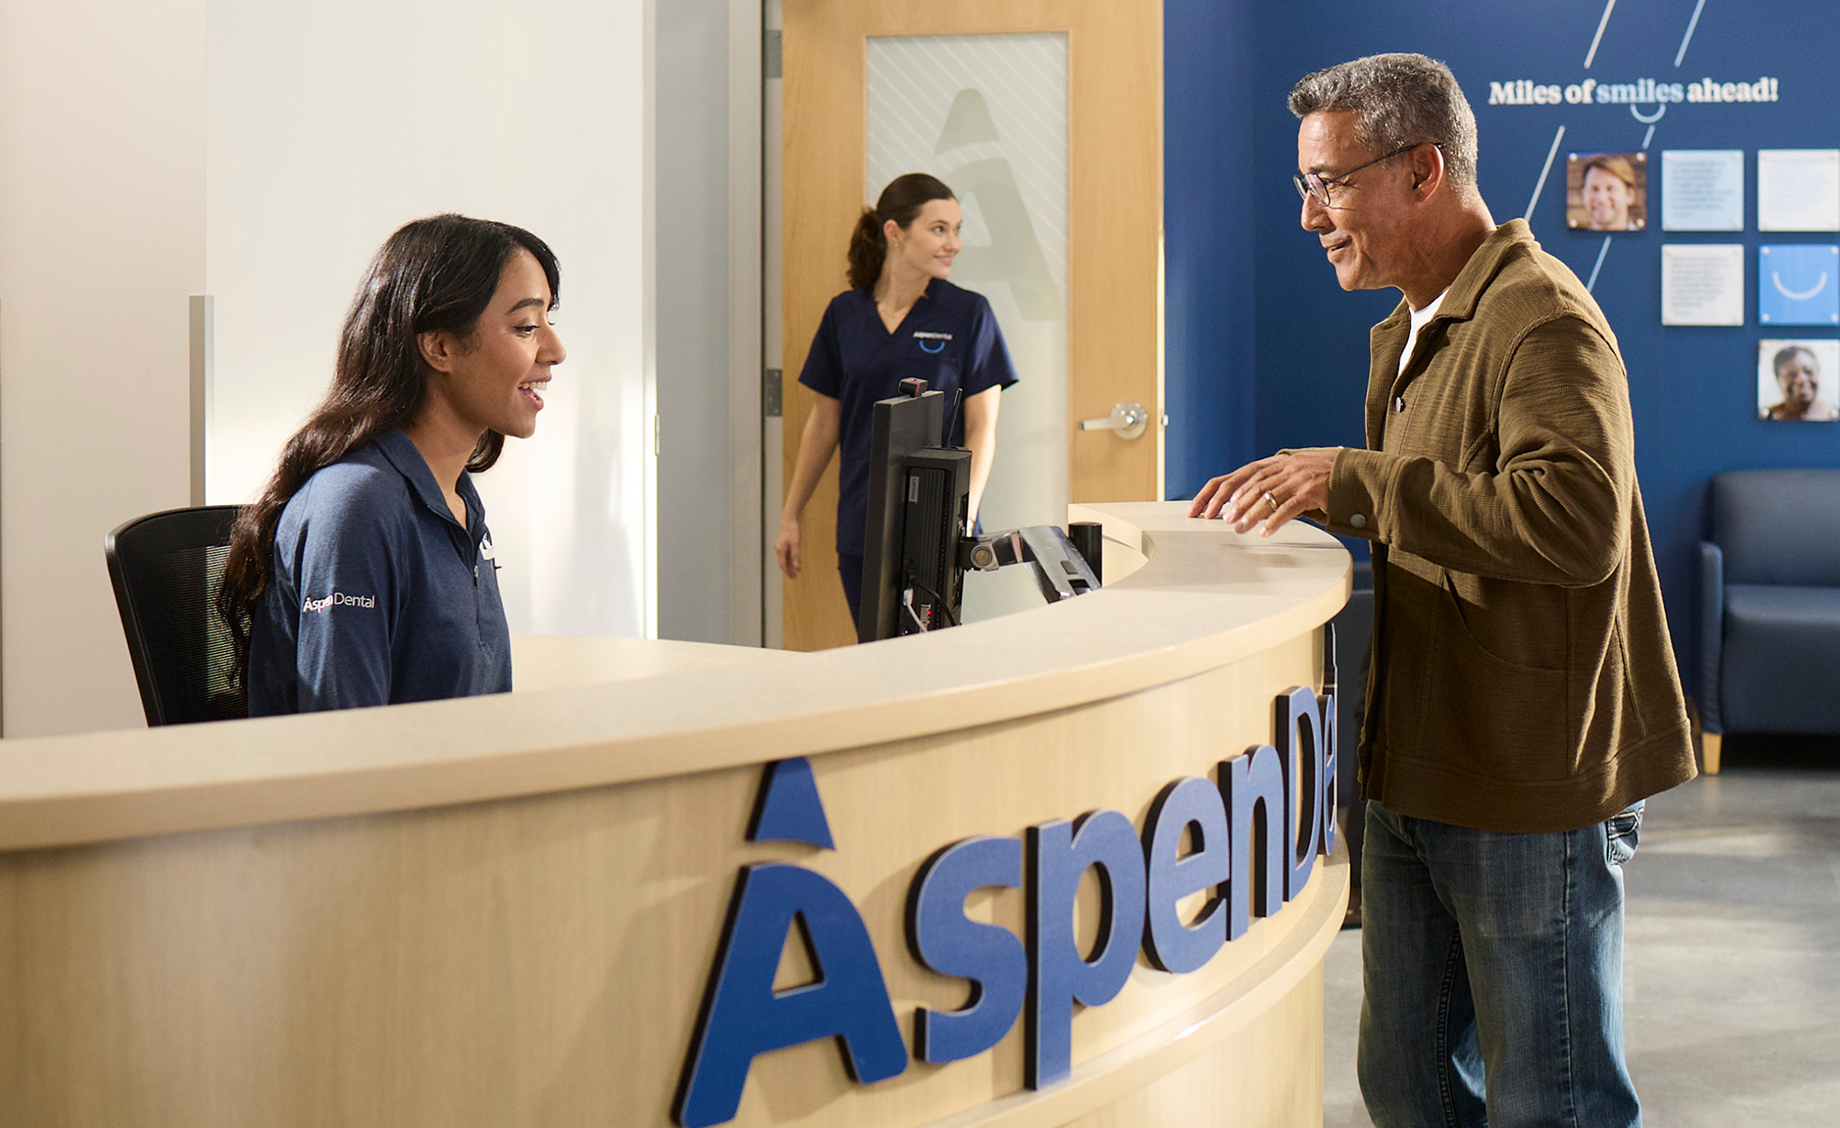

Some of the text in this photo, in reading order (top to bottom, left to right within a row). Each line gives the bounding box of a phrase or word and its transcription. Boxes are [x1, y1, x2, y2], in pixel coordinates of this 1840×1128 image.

[1489, 77, 1779, 105] Miles of smiles ahead!
